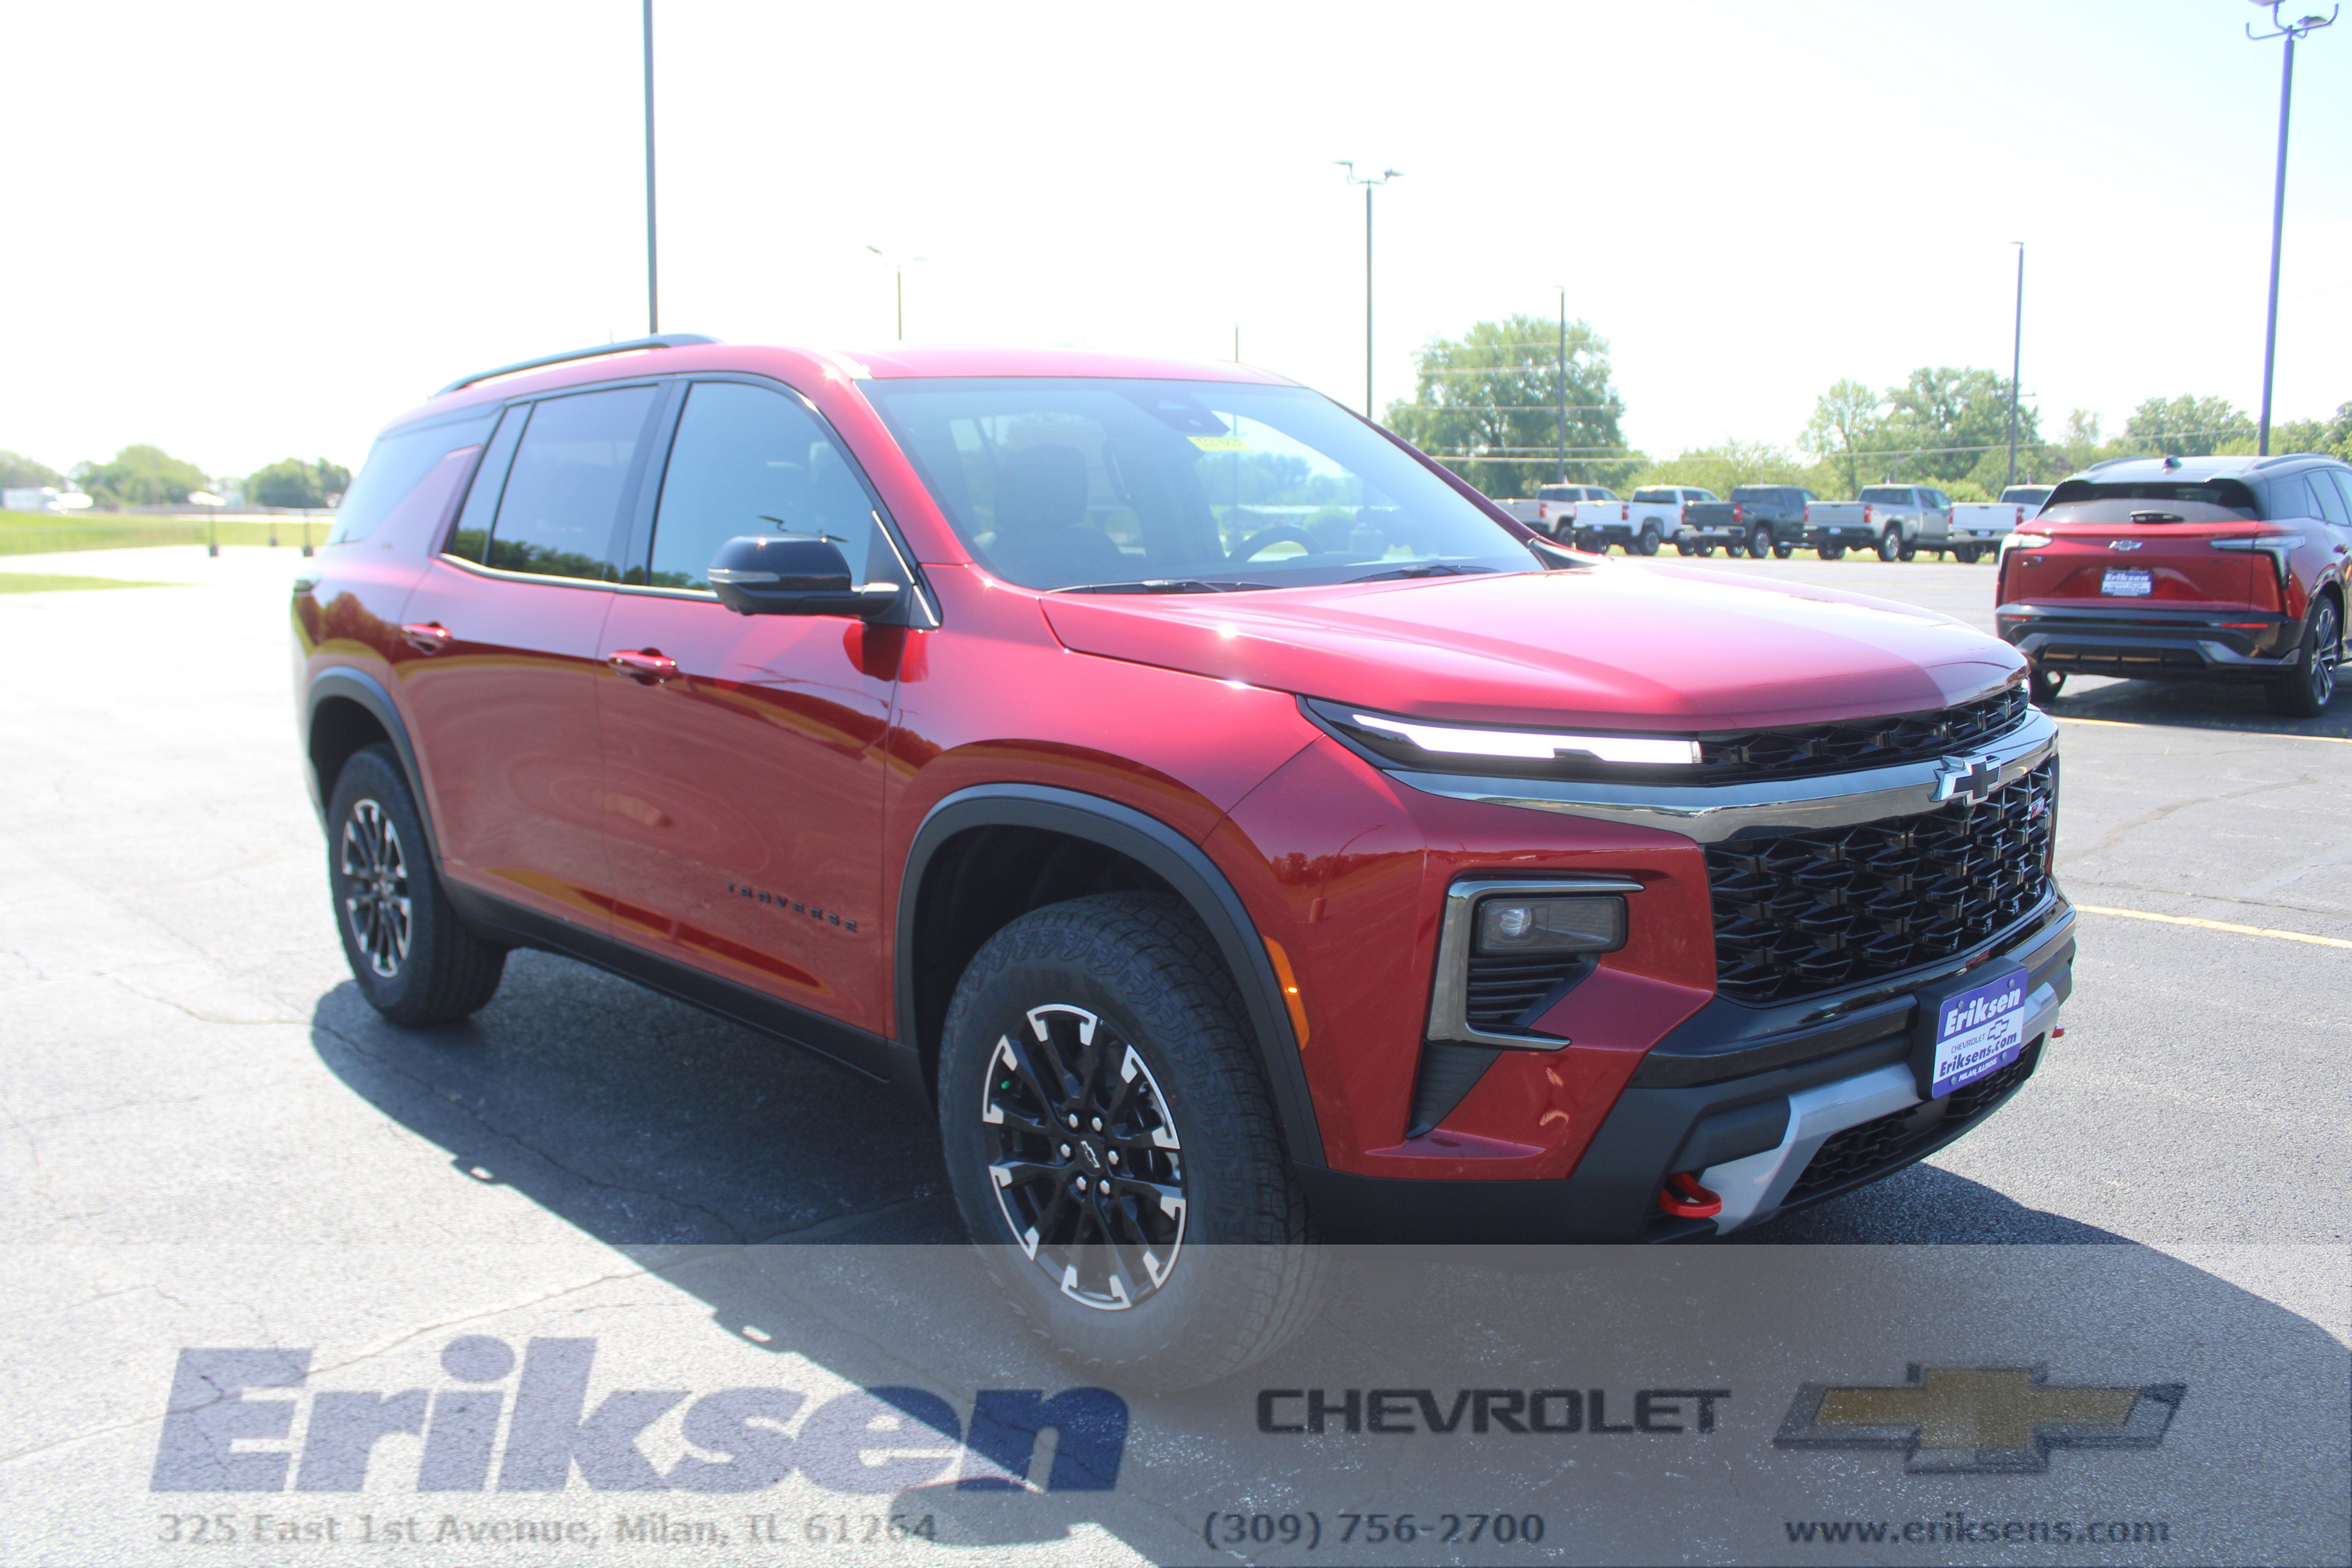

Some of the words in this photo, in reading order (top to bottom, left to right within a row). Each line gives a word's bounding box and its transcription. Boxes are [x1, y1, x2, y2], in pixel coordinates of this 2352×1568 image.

[725, 882, 857, 933] TRAVERSE
[1944, 988, 2021, 1037] Eriksen
[1939, 1032, 2017, 1078] Eriksens.com
[1951, 1033, 1986, 1054] CHEVROLET
[1958, 1067, 1977, 1082] MILAN,
[1977, 1058, 1998, 1074] ILLINOIS
